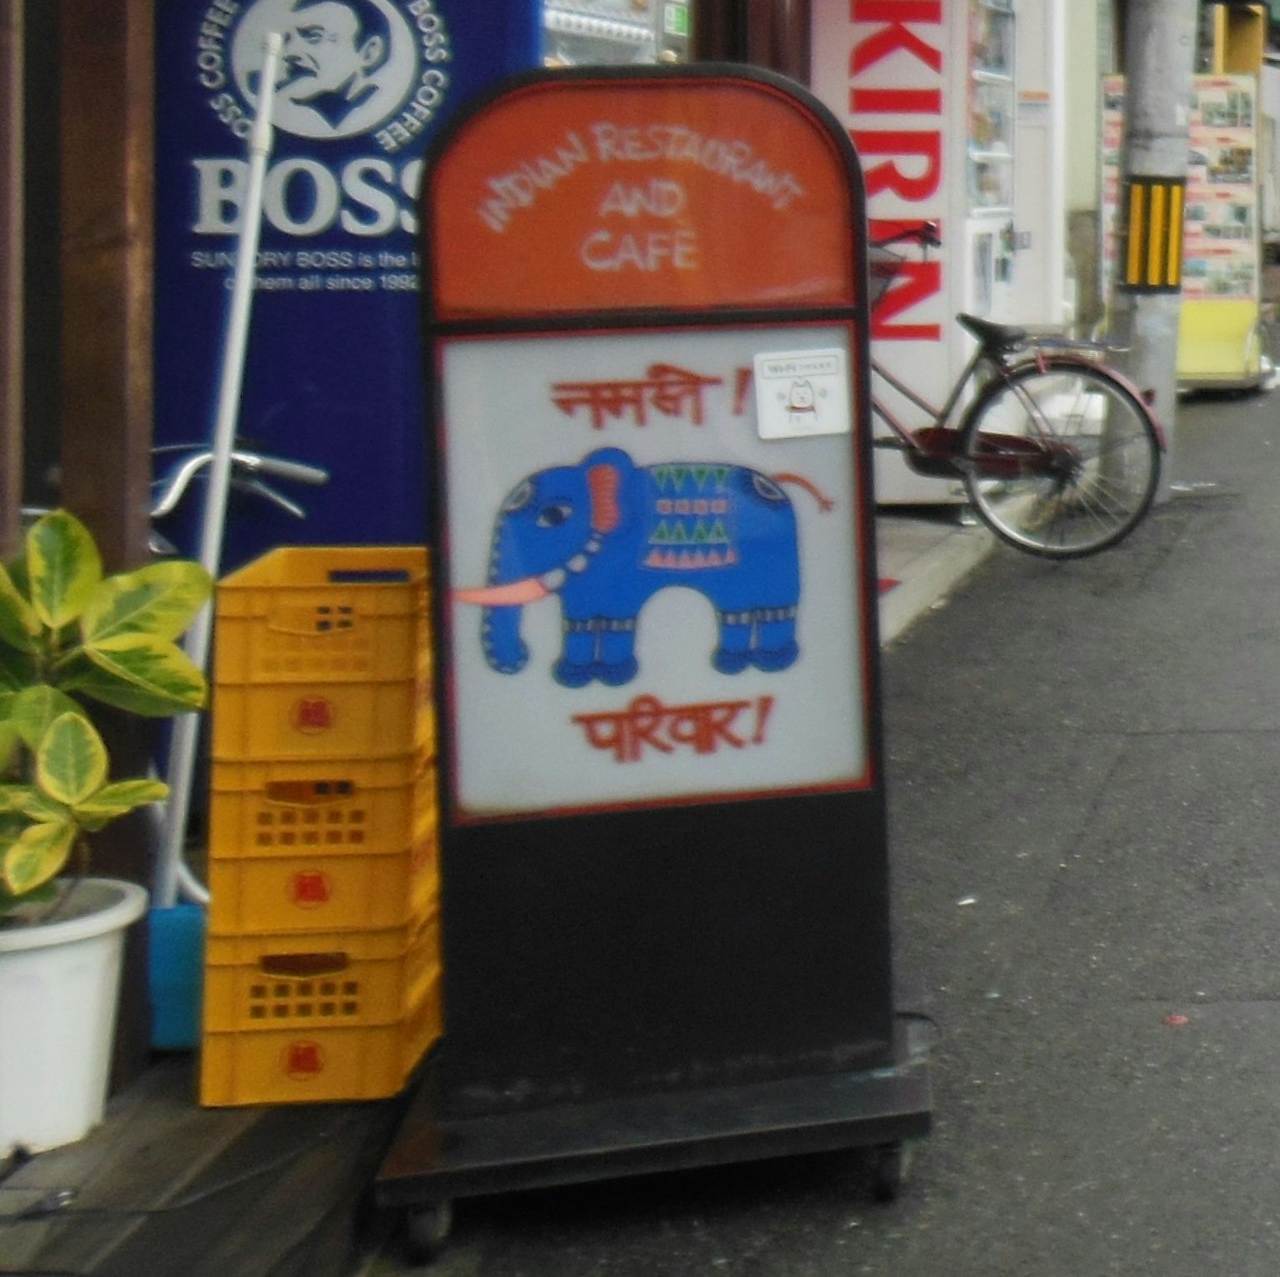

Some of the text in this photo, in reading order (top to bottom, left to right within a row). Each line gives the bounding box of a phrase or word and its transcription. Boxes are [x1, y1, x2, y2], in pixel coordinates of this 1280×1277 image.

[373, 68, 446, 152] COFFEE
[599, 178, 688, 219] AND
[190, 252, 291, 269] SUNORY
[297, 252, 353, 269] BOSS
[358, 252, 373, 269] is
[379, 252, 407, 269] the
[326, 275, 373, 291] since
